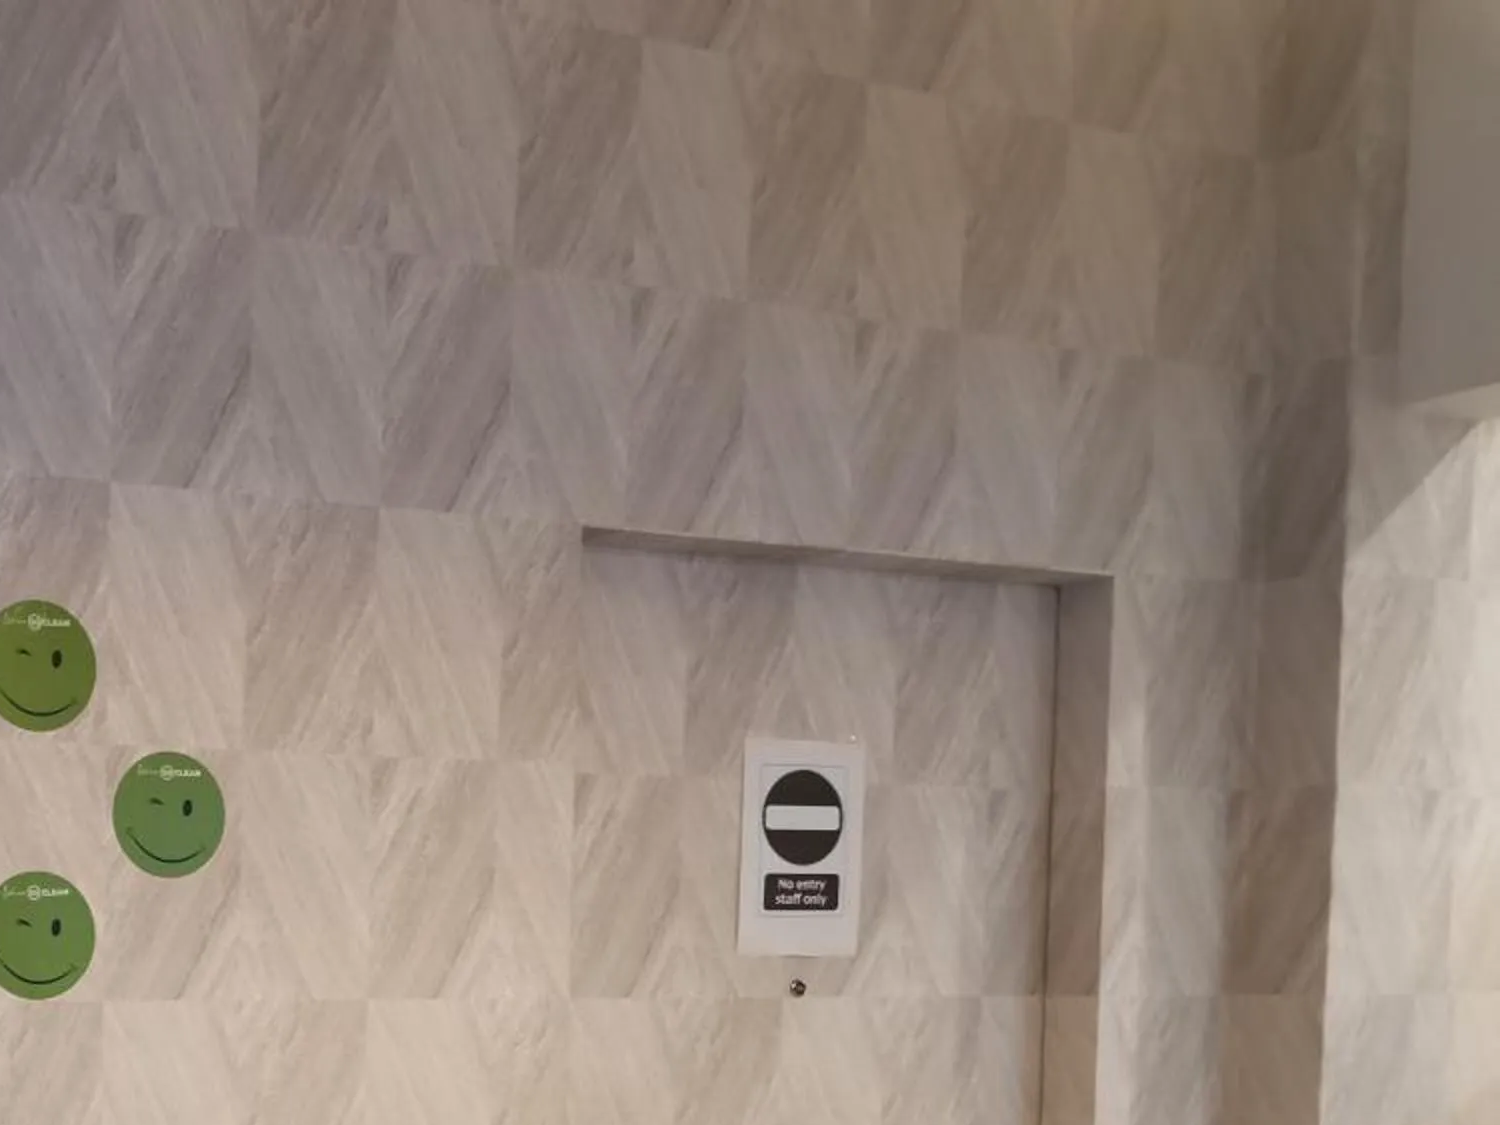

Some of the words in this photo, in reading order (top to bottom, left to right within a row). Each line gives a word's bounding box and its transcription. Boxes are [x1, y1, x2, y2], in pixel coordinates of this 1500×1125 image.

[778, 879, 794, 889] No
[796, 879, 827, 893] entry
[775, 893, 802, 905] staff
[803, 894, 829, 907] only
